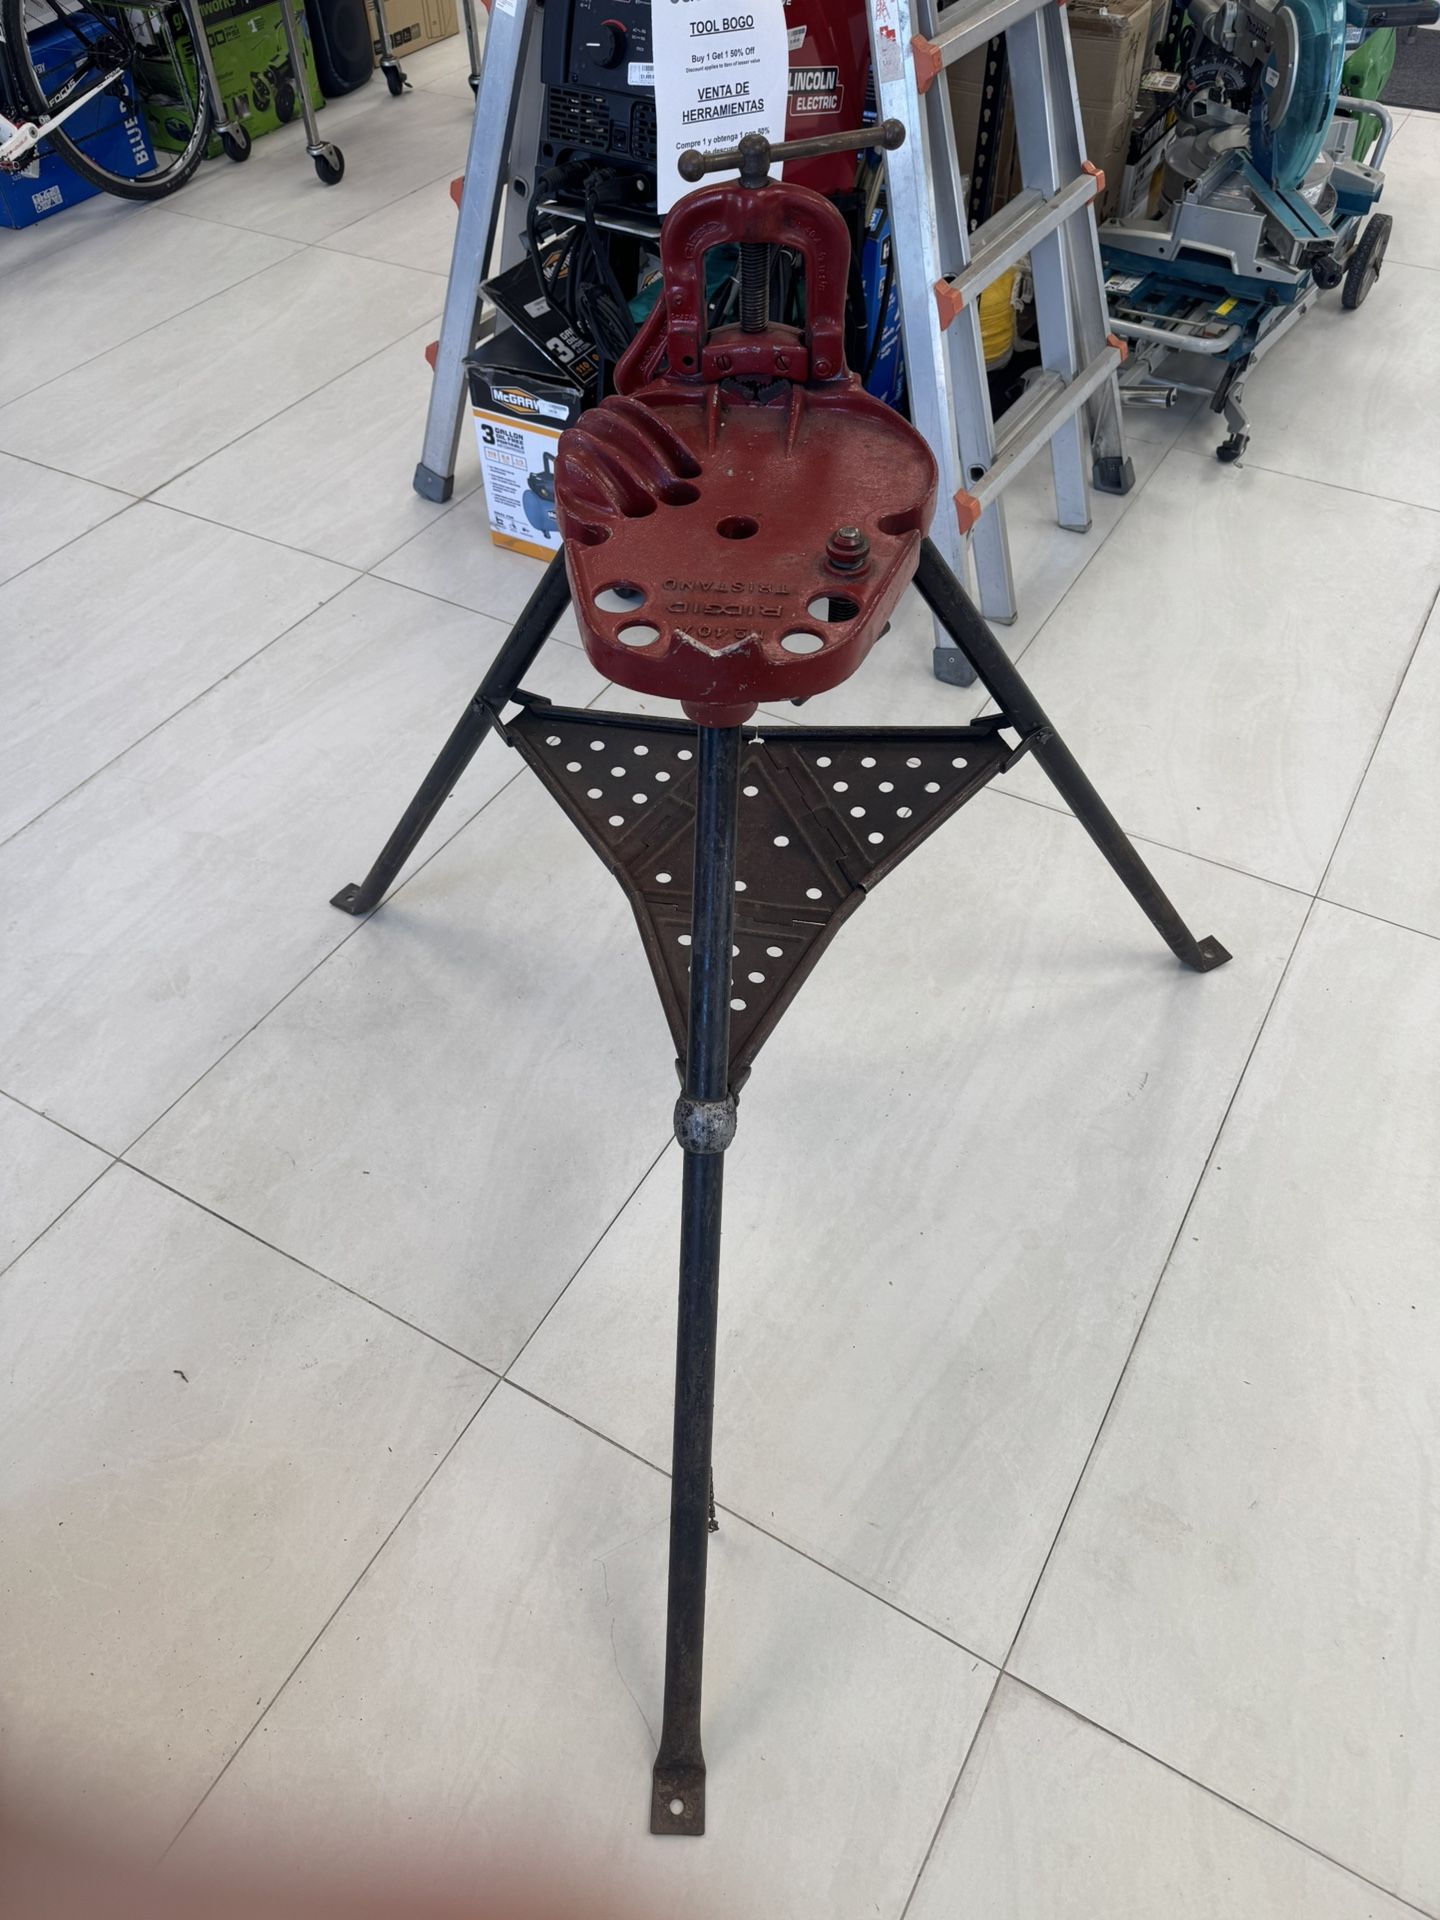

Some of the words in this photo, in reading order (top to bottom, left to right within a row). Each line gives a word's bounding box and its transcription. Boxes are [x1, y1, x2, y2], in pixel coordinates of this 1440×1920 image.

[690, 20, 719, 34] TOOL
[723, 15, 754, 30] BOGO
[692, 54, 705, 64] Buy
[712, 51, 723, 60] Get
[730, 48, 743, 58] 50%
[745, 46, 755, 55] Off
[698, 84, 732, 100] VENTA
[735, 81, 750, 94] DE
[787, 71, 836, 91] LINCOLN
[49, 78, 77, 107] FOCUS
[682, 98, 764, 122] HERRAMIENTAS
[796, 95, 838, 111] ELECTRIC
[124, 114, 149, 166] BLUE
[675, 139, 700, 151] Compre
[713, 133, 738, 144] obtenga
[712, 145, 739, 155] descuen
[545, 336, 575, 363] 3
[481, 423, 496, 445] 3
[495, 427, 524, 440] GALLON
[663, 578, 790, 596] TRISTAND
[667, 602, 783, 618] RIDGID
